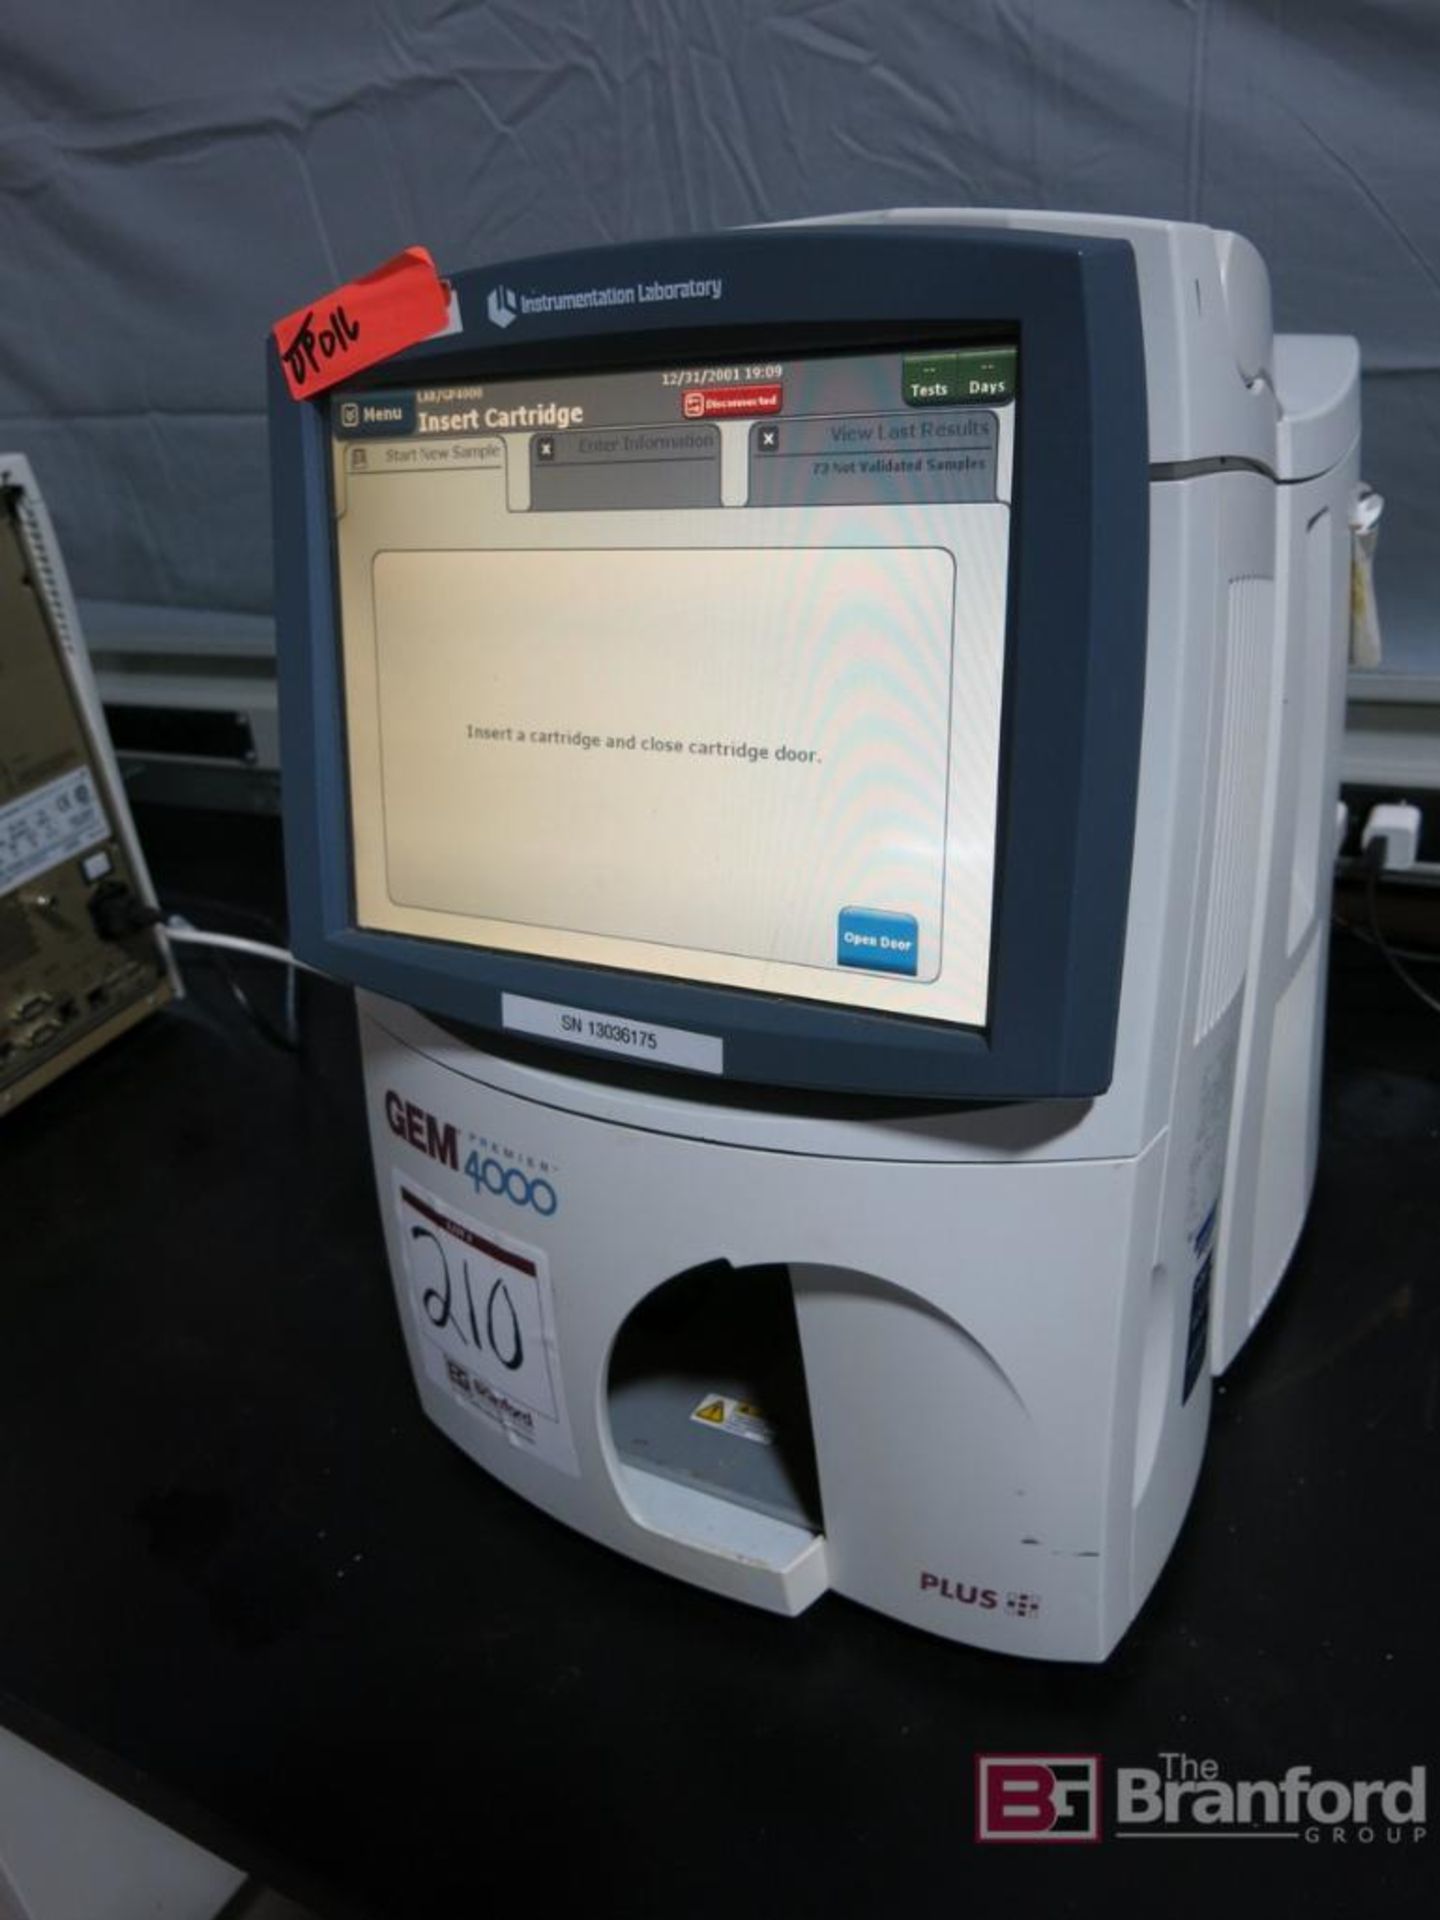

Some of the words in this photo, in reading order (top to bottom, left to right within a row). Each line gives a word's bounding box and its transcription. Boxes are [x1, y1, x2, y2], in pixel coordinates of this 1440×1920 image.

[521, 286, 635, 314] Instrumentation
[637, 278, 722, 302] Laboratory
[662, 367, 740, 386] 12/31/2001
[745, 364, 782, 380] 19:09
[911, 382, 948, 398] Tests
[969, 380, 1005, 395] Days
[363, 405, 402, 422] Menu
[419, 408, 479, 432] Insert
[485, 403, 583, 428] Cartridge
[831, 424, 873, 441] View
[878, 422, 916, 440] Last
[921, 419, 990, 438] Results
[623, 434, 714, 450] Information
[386, 448, 417, 464] Start
[452, 443, 500, 460] Sample
[860, 459, 922, 474] Validated
[927, 456, 986, 472] Samples
[466, 724, 513, 742] Insert
[516, 729, 526, 742] a
[529, 730, 601, 750] cartridge
[605, 734, 636, 750] and
[640, 736, 683, 753] close
[688, 741, 768, 763] cartridge
[774, 745, 823, 763] door.
[843, 931, 878, 947] Open
[879, 936, 912, 952] Door
[561, 1014, 583, 1032] SN
[589, 1020, 658, 1050] 13036175
[385, 1089, 460, 1172] GEM
[464, 1150, 558, 1217] 4000
[411, 1225, 524, 1371] 210
[920, 1571, 999, 1610] PLUS
